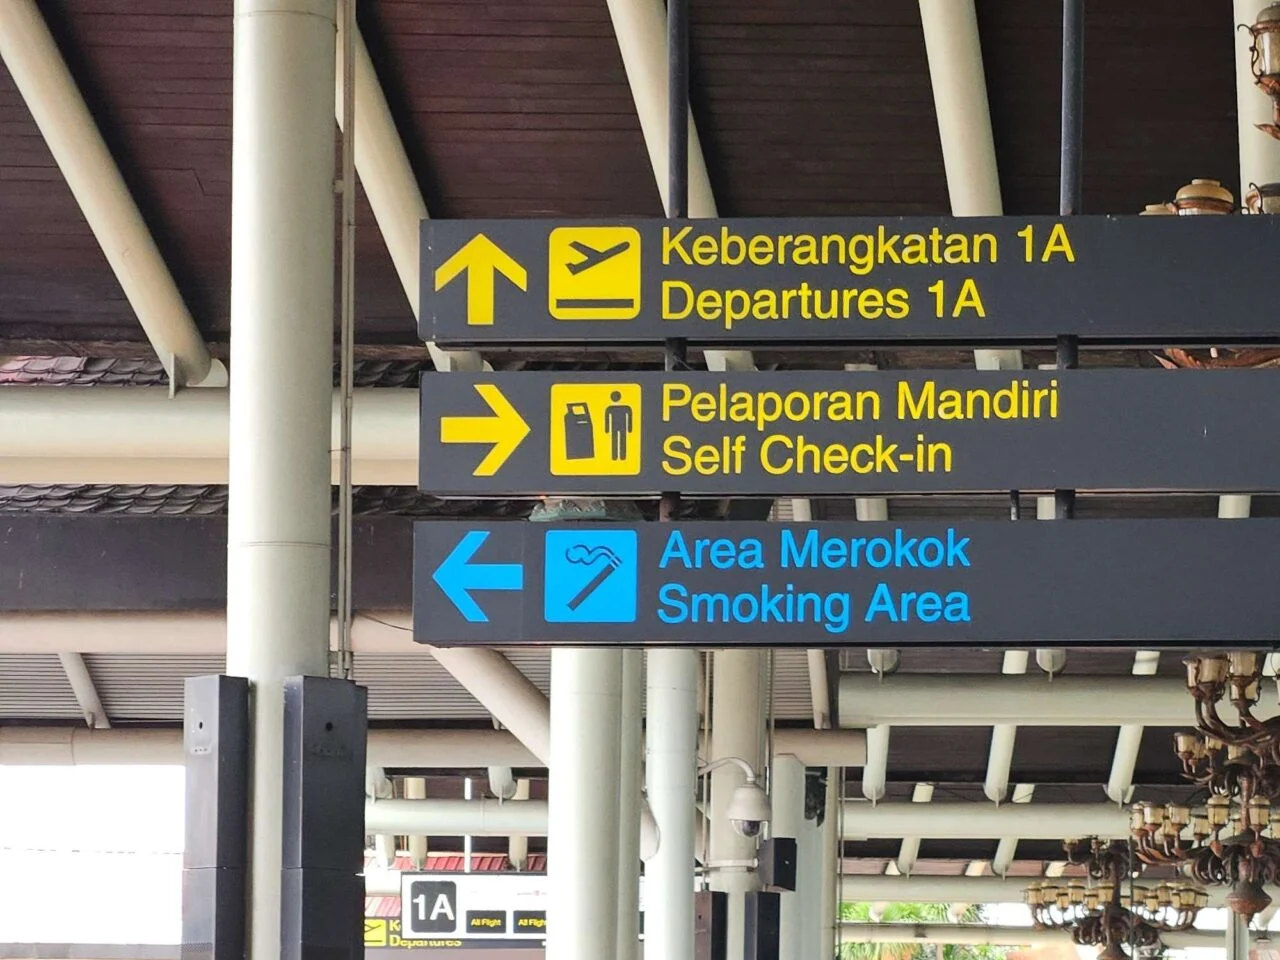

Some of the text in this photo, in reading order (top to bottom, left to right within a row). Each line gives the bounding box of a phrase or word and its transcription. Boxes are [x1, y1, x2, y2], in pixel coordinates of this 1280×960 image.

[661, 223, 1076, 276] Keberangkatan 1A
[661, 278, 986, 328] Departures 1A
[661, 380, 1060, 430] Pelaporan Mandiri
[660, 433, 953, 476] Self Check-in
[658, 527, 972, 571] Area Merokok
[656, 581, 972, 635] Smoking Area
[412, 893, 456, 921] 1A
[481, 918, 502, 927] Flight
